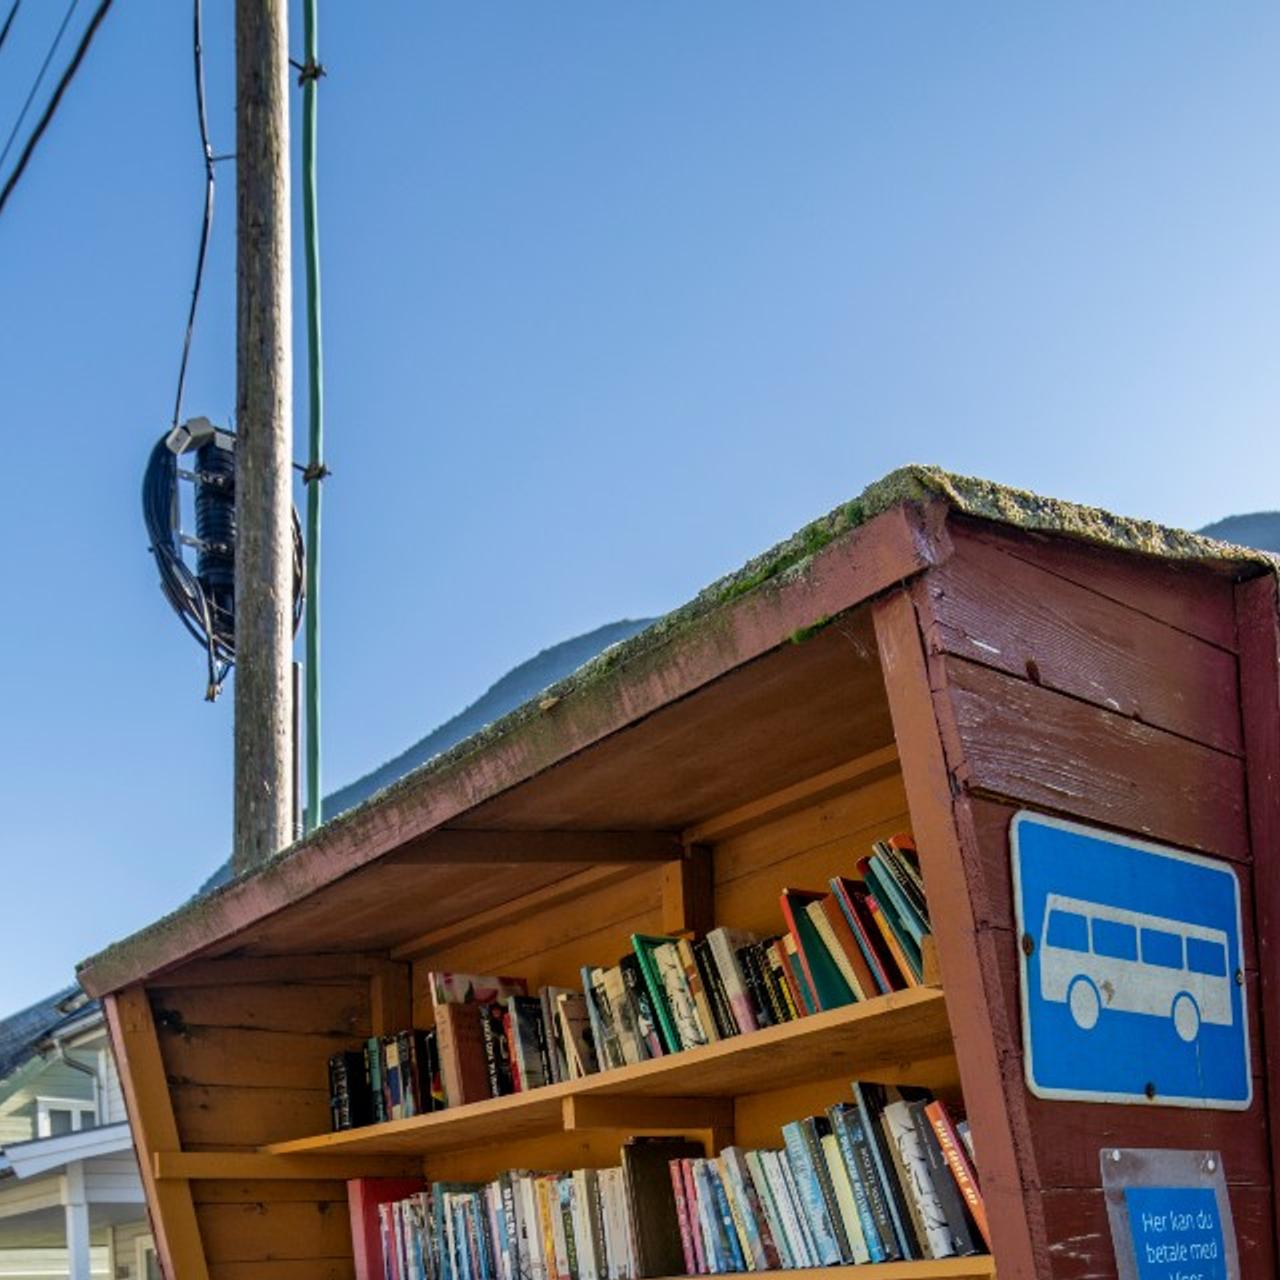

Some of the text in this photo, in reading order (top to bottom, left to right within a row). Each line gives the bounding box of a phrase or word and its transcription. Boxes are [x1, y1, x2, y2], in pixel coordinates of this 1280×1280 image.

[1142, 1209, 1213, 1233] Her kan du
[1145, 1238, 1218, 1264] betale med
